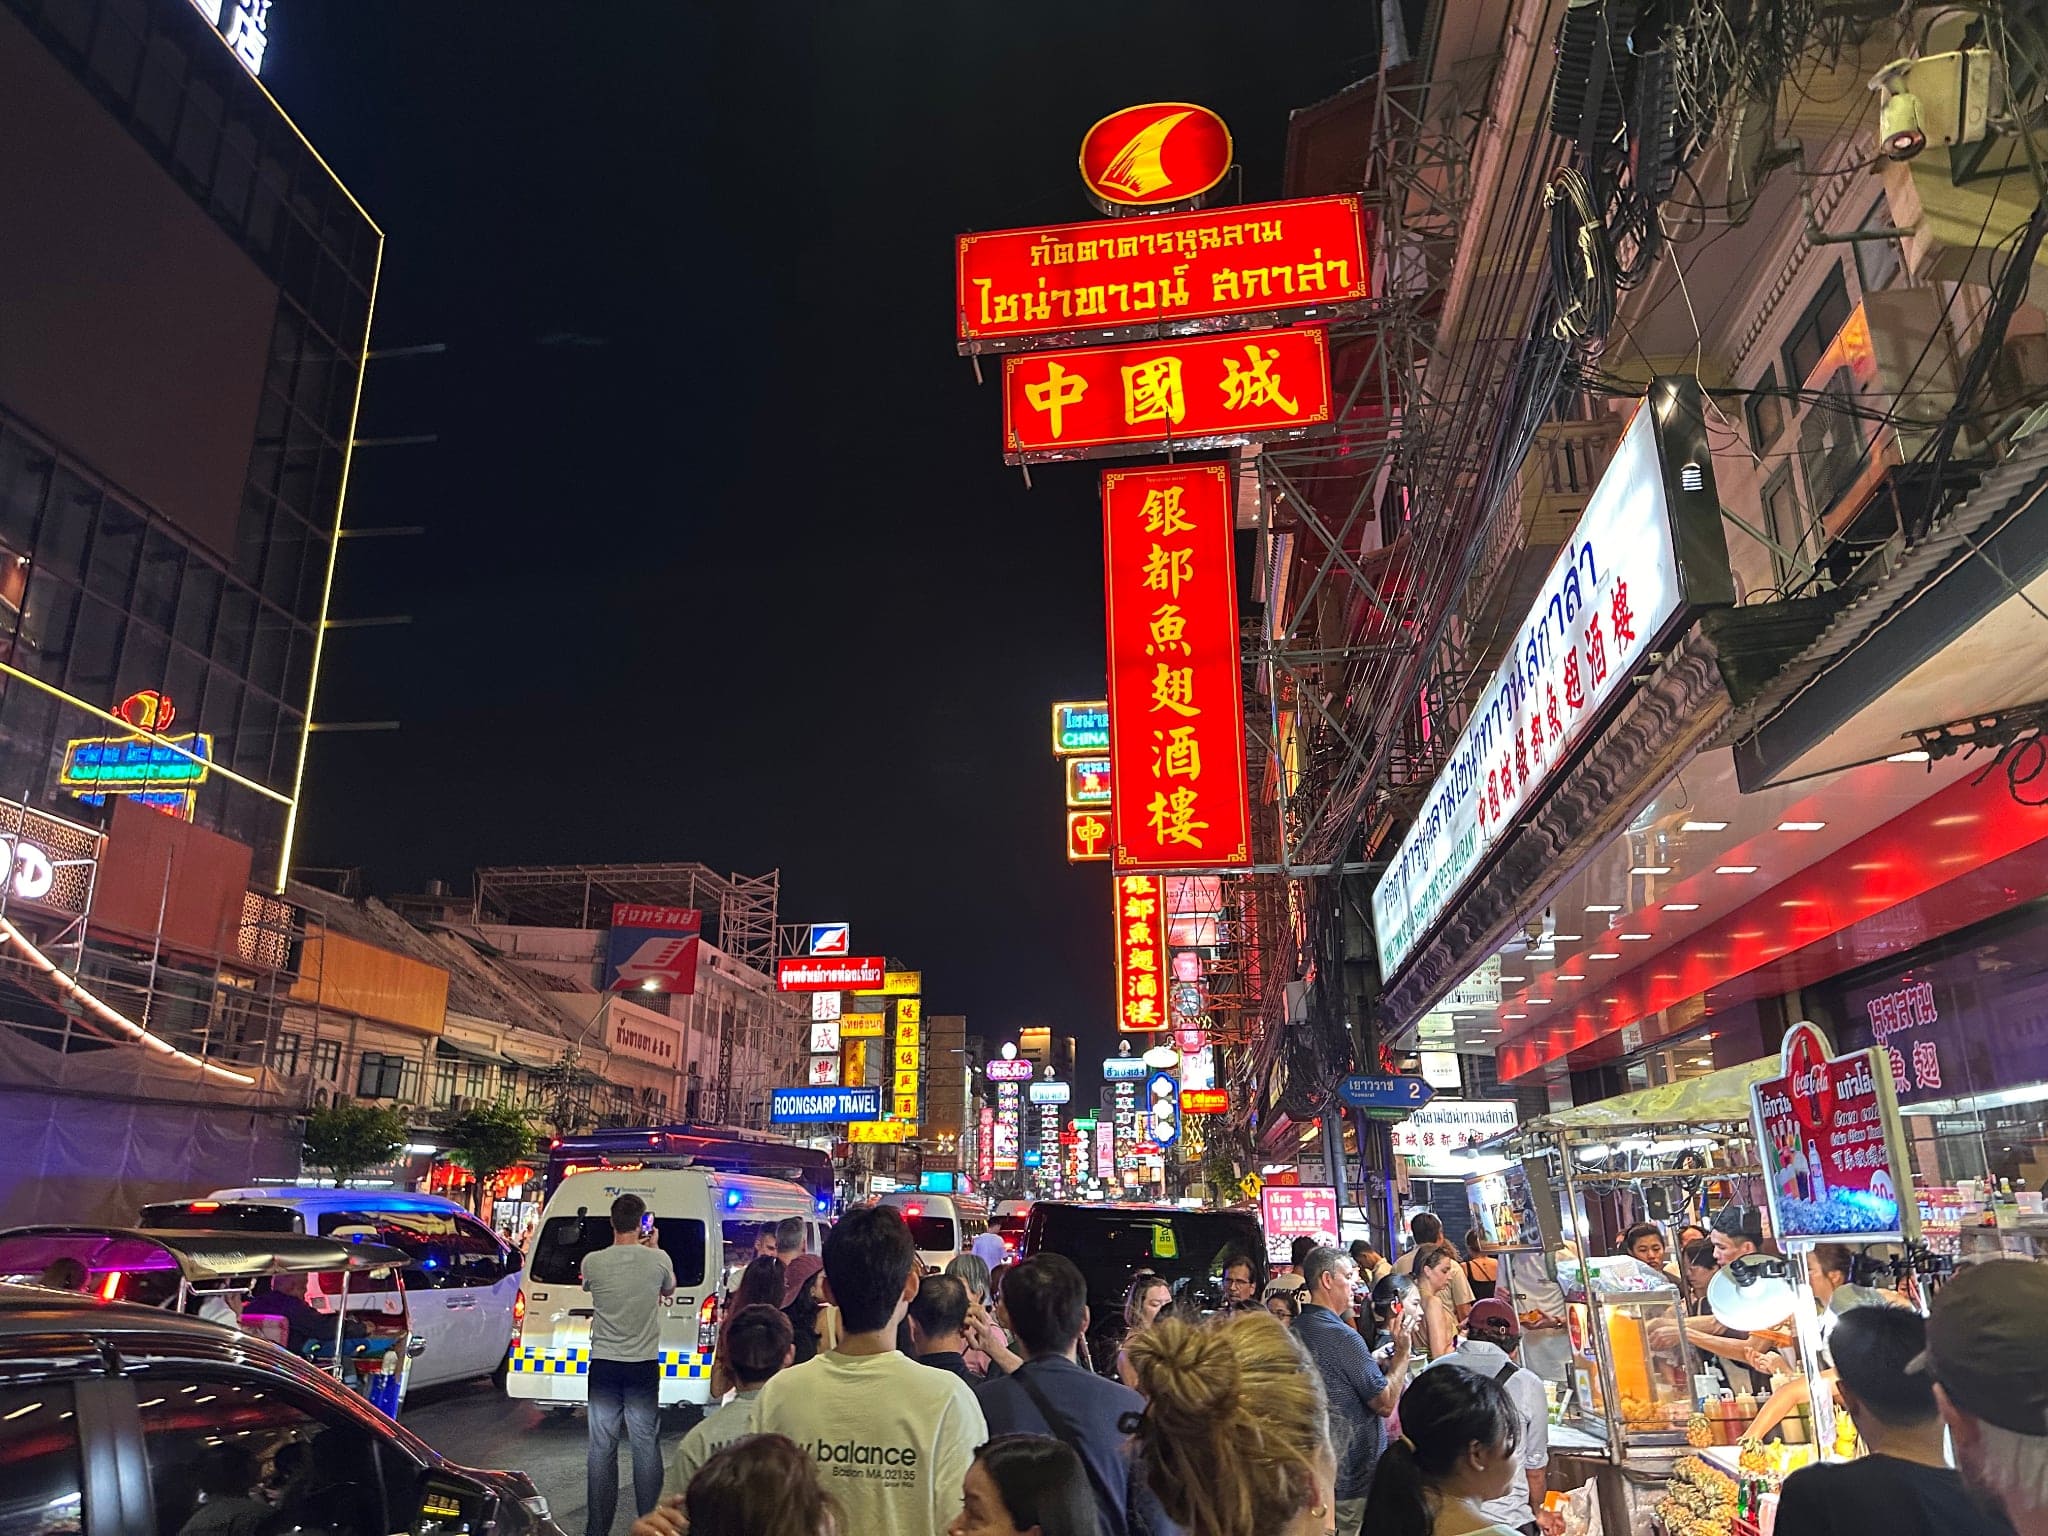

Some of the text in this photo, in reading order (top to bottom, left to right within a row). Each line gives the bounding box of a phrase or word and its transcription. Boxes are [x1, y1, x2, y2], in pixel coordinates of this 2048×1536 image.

[973, 247, 1351, 324] ไชน่าทาวน์ สกาล่า
[1025, 344, 1299, 439] 中國城
[1137, 486, 1210, 849] 銀都魚翅酒樓
[1076, 816, 1105, 855] 中
[774, 1094, 877, 1116] ROONGSARP TRAVEL
[1349, 1080, 1420, 1099] เยาวราช 2
[817, 1439, 917, 1466] balance
